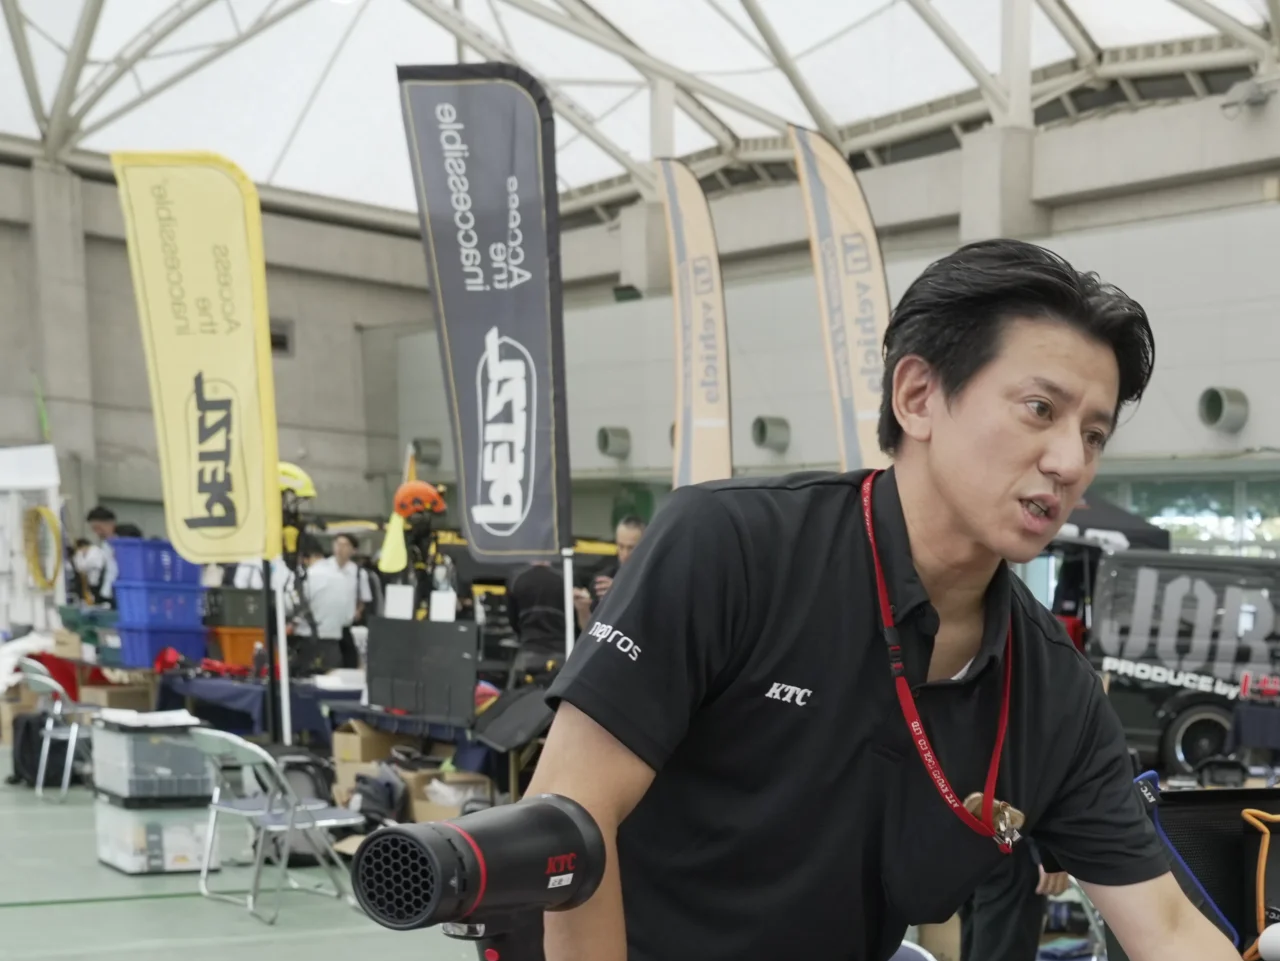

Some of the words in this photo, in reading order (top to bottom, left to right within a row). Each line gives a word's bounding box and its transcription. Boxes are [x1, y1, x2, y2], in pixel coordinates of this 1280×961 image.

[588, 620, 642, 662] nepros
[1102, 656, 1214, 692] PRODUCE
[765, 682, 812, 707] KTC
[1140, 785, 1157, 803] KTC
[544, 852, 578, 875] KTC
